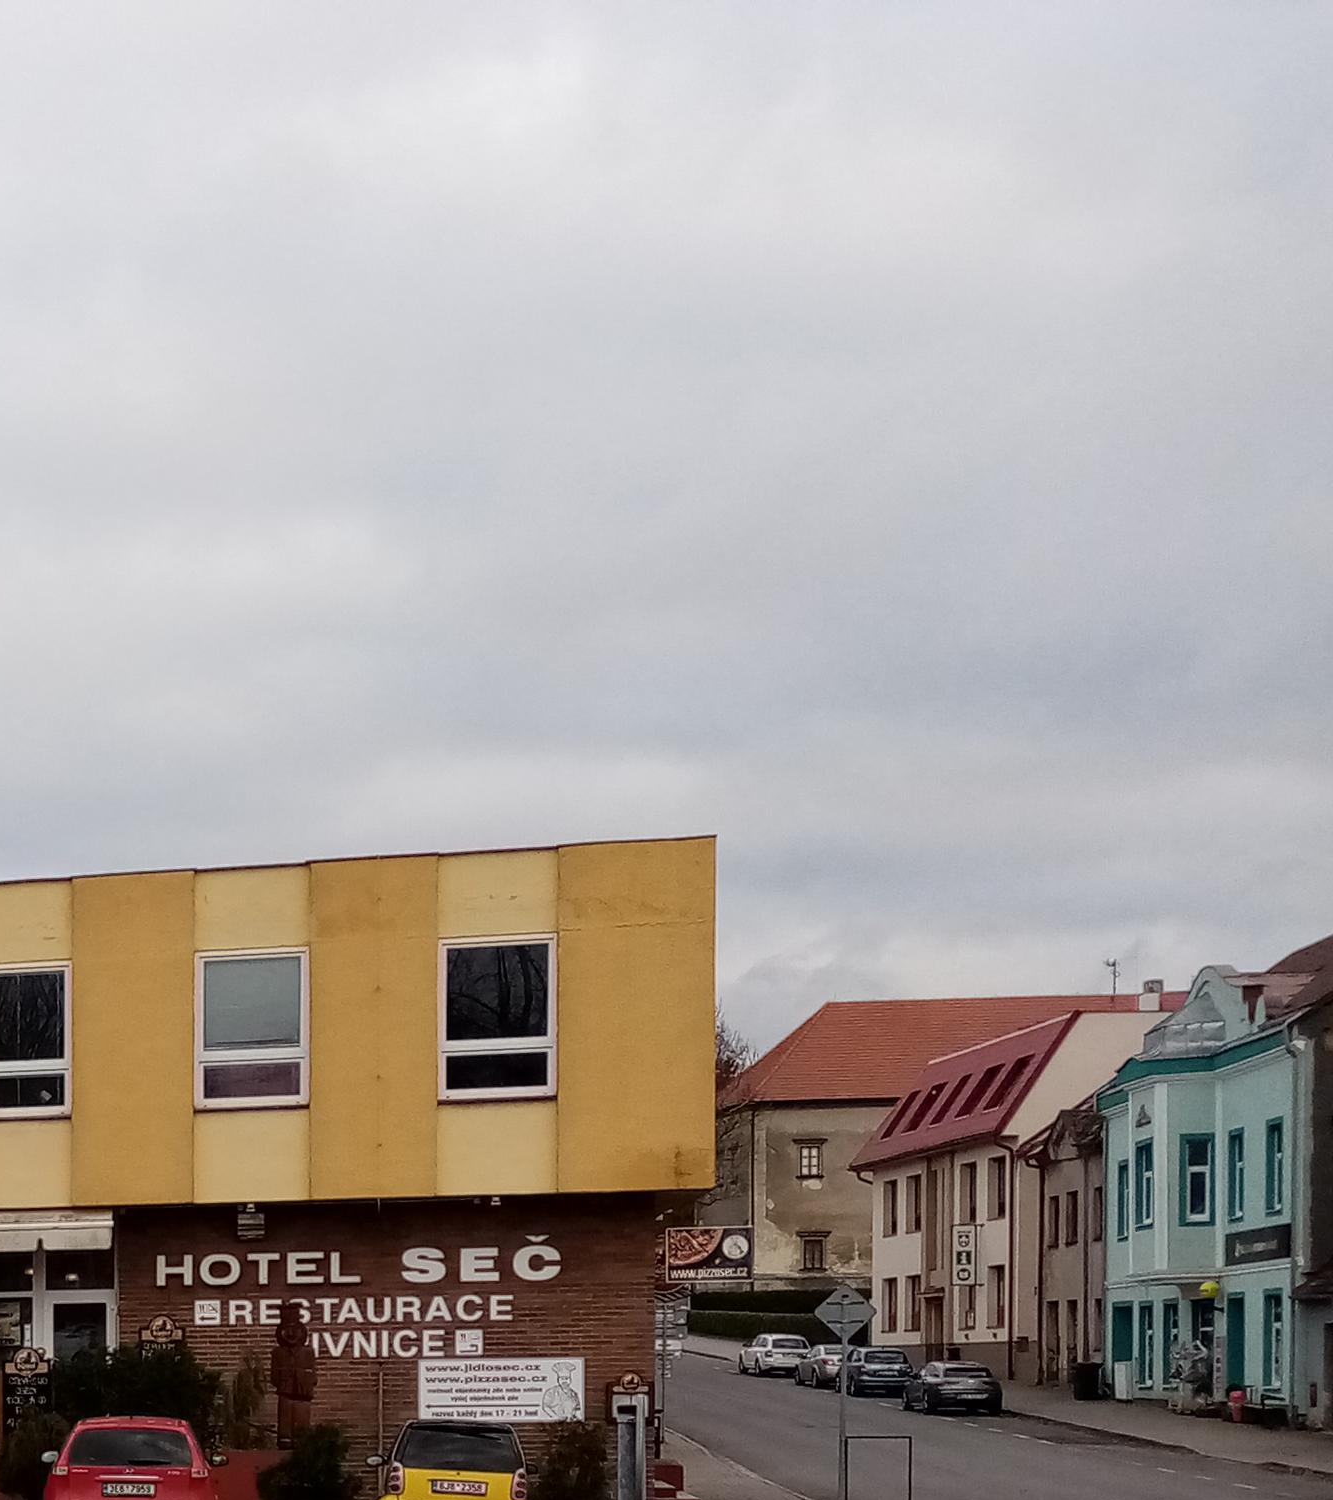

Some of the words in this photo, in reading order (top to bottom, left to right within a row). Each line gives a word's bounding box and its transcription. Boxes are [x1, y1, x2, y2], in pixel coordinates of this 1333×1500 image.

[155, 1250, 363, 1287] HOTEL
[400, 1234, 562, 1283] SEČ
[304, 1329, 446, 1358] IVNICE
